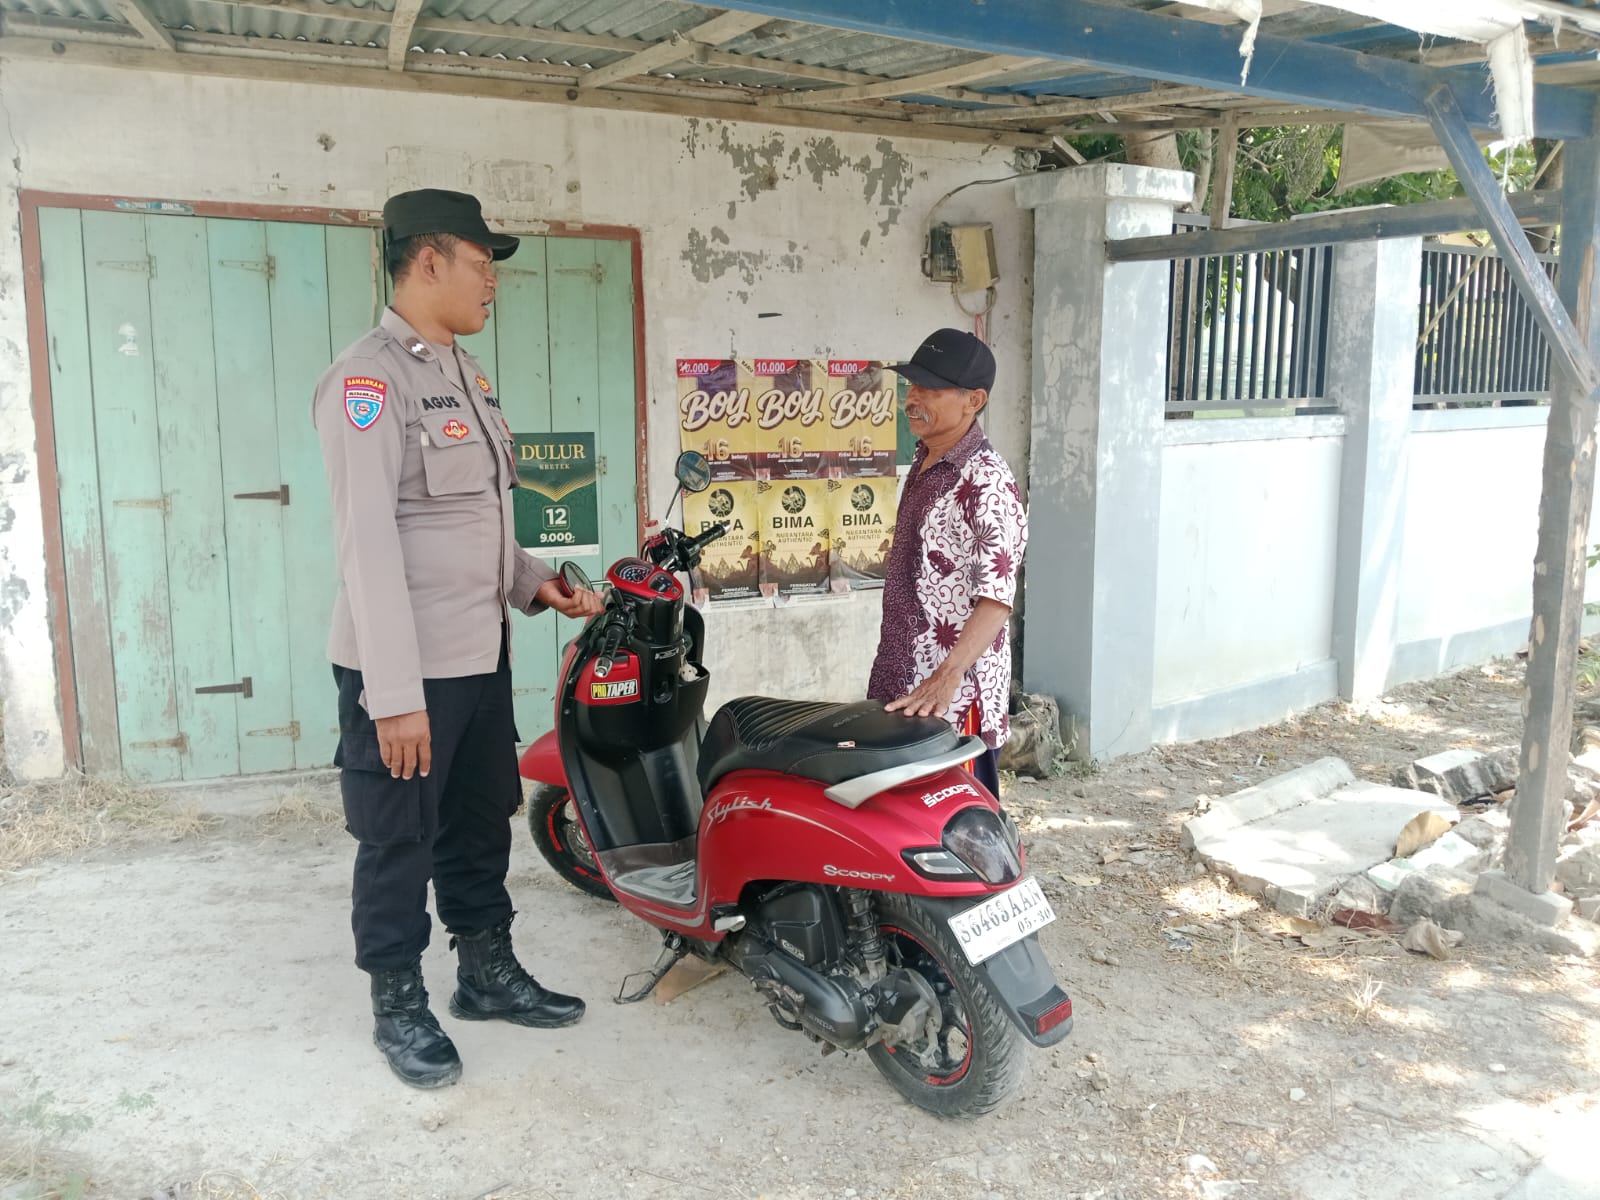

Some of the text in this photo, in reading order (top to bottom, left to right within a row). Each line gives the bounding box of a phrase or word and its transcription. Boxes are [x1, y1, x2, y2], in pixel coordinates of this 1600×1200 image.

[757, 362, 786, 373] 10.000
[830, 363, 858, 373] 10.000
[421, 396, 461, 411] AGUS
[521, 444, 586, 460] DULUR
[703, 438, 730, 461] 16
[778, 436, 802, 459] 16
[849, 436, 872, 458] 16
[545, 508, 567, 525] 12
[773, 516, 814, 529] BIMA
[842, 513, 882, 526] BIMA
[700, 519, 744, 533] BA
